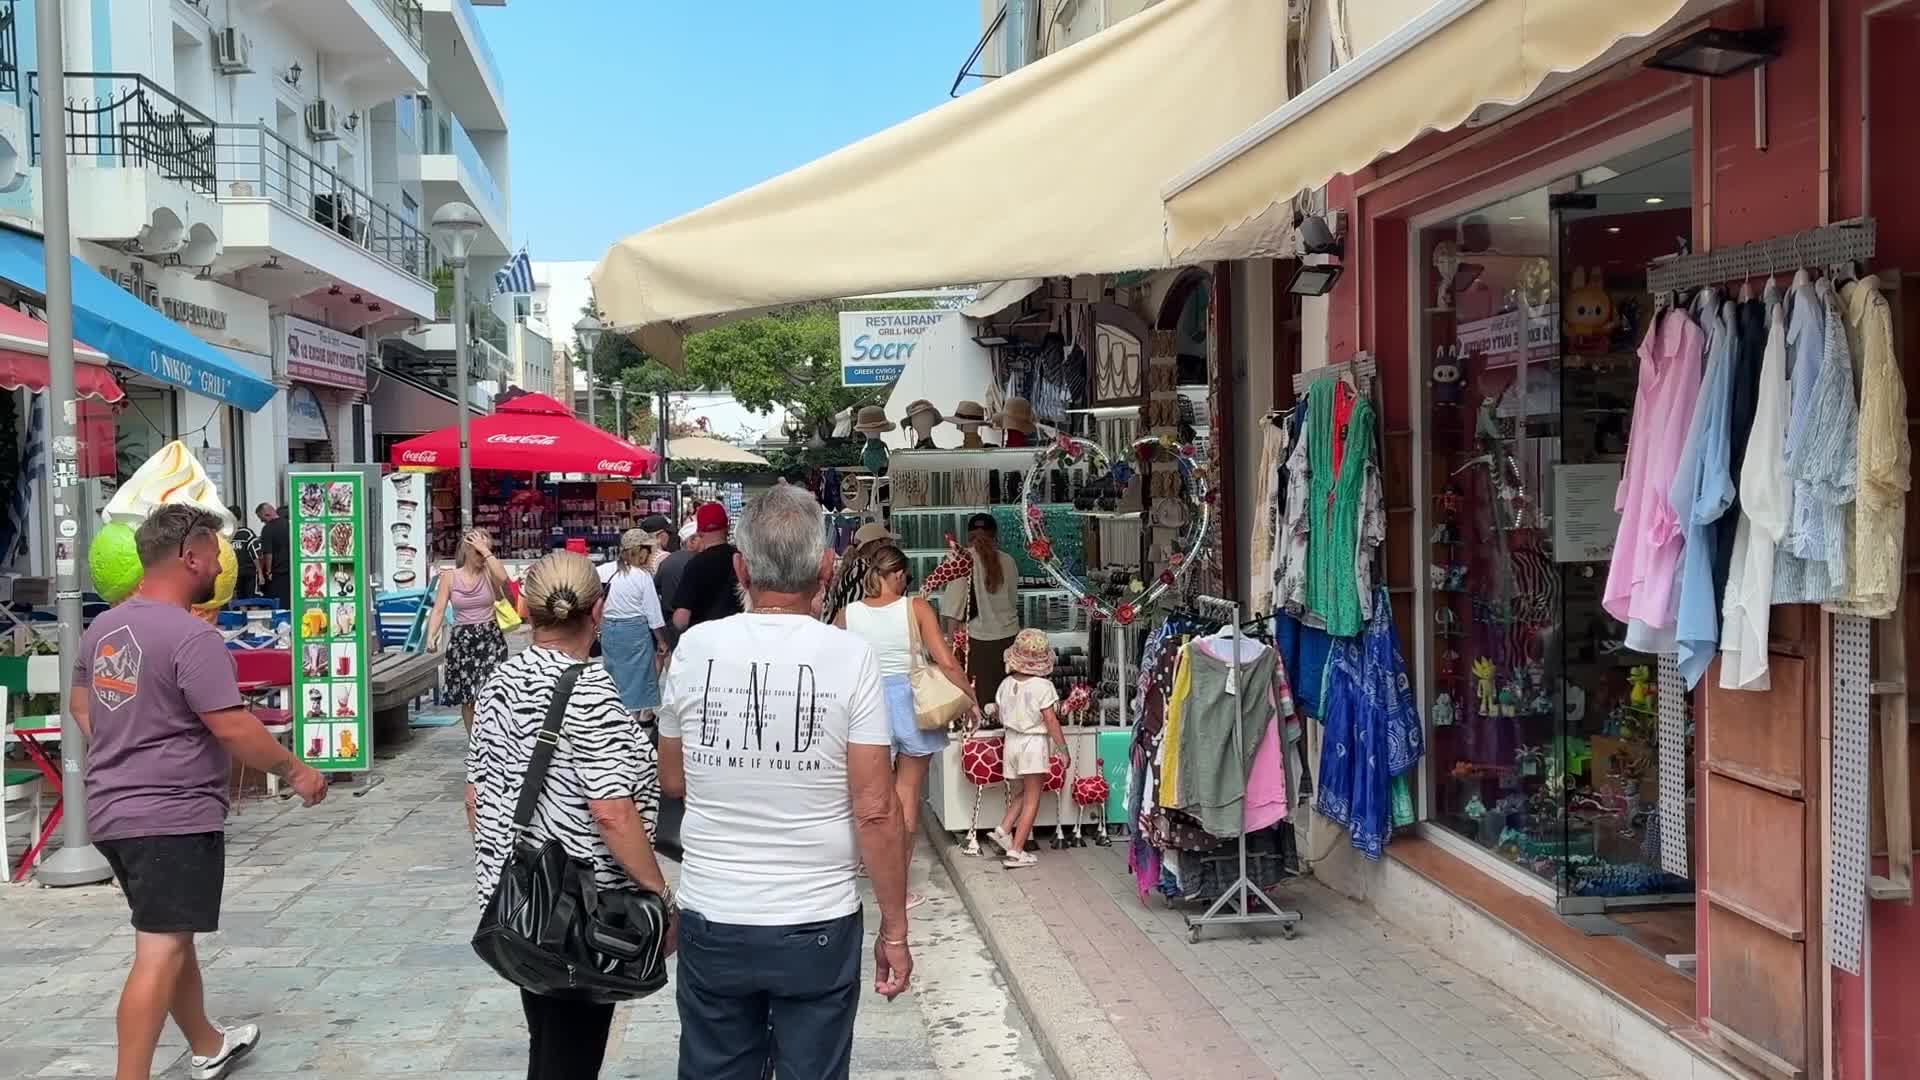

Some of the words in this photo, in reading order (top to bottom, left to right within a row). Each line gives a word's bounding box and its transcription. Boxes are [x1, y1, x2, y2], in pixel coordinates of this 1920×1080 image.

[192, 303, 227, 330] LUXURY
[865, 314, 943, 327] RESTAURANT
[879, 328, 901, 336] GRILL
[487, 434, 560, 445] Coca-Cola
[402, 450, 438, 462] Coca-Cola
[597, 459, 633, 473] Coca-Cola
[692, 752, 722, 768] CATCH
[728, 757, 745, 768] ME
[751, 758, 762, 769] IF
[769, 758, 791, 771] YOU
